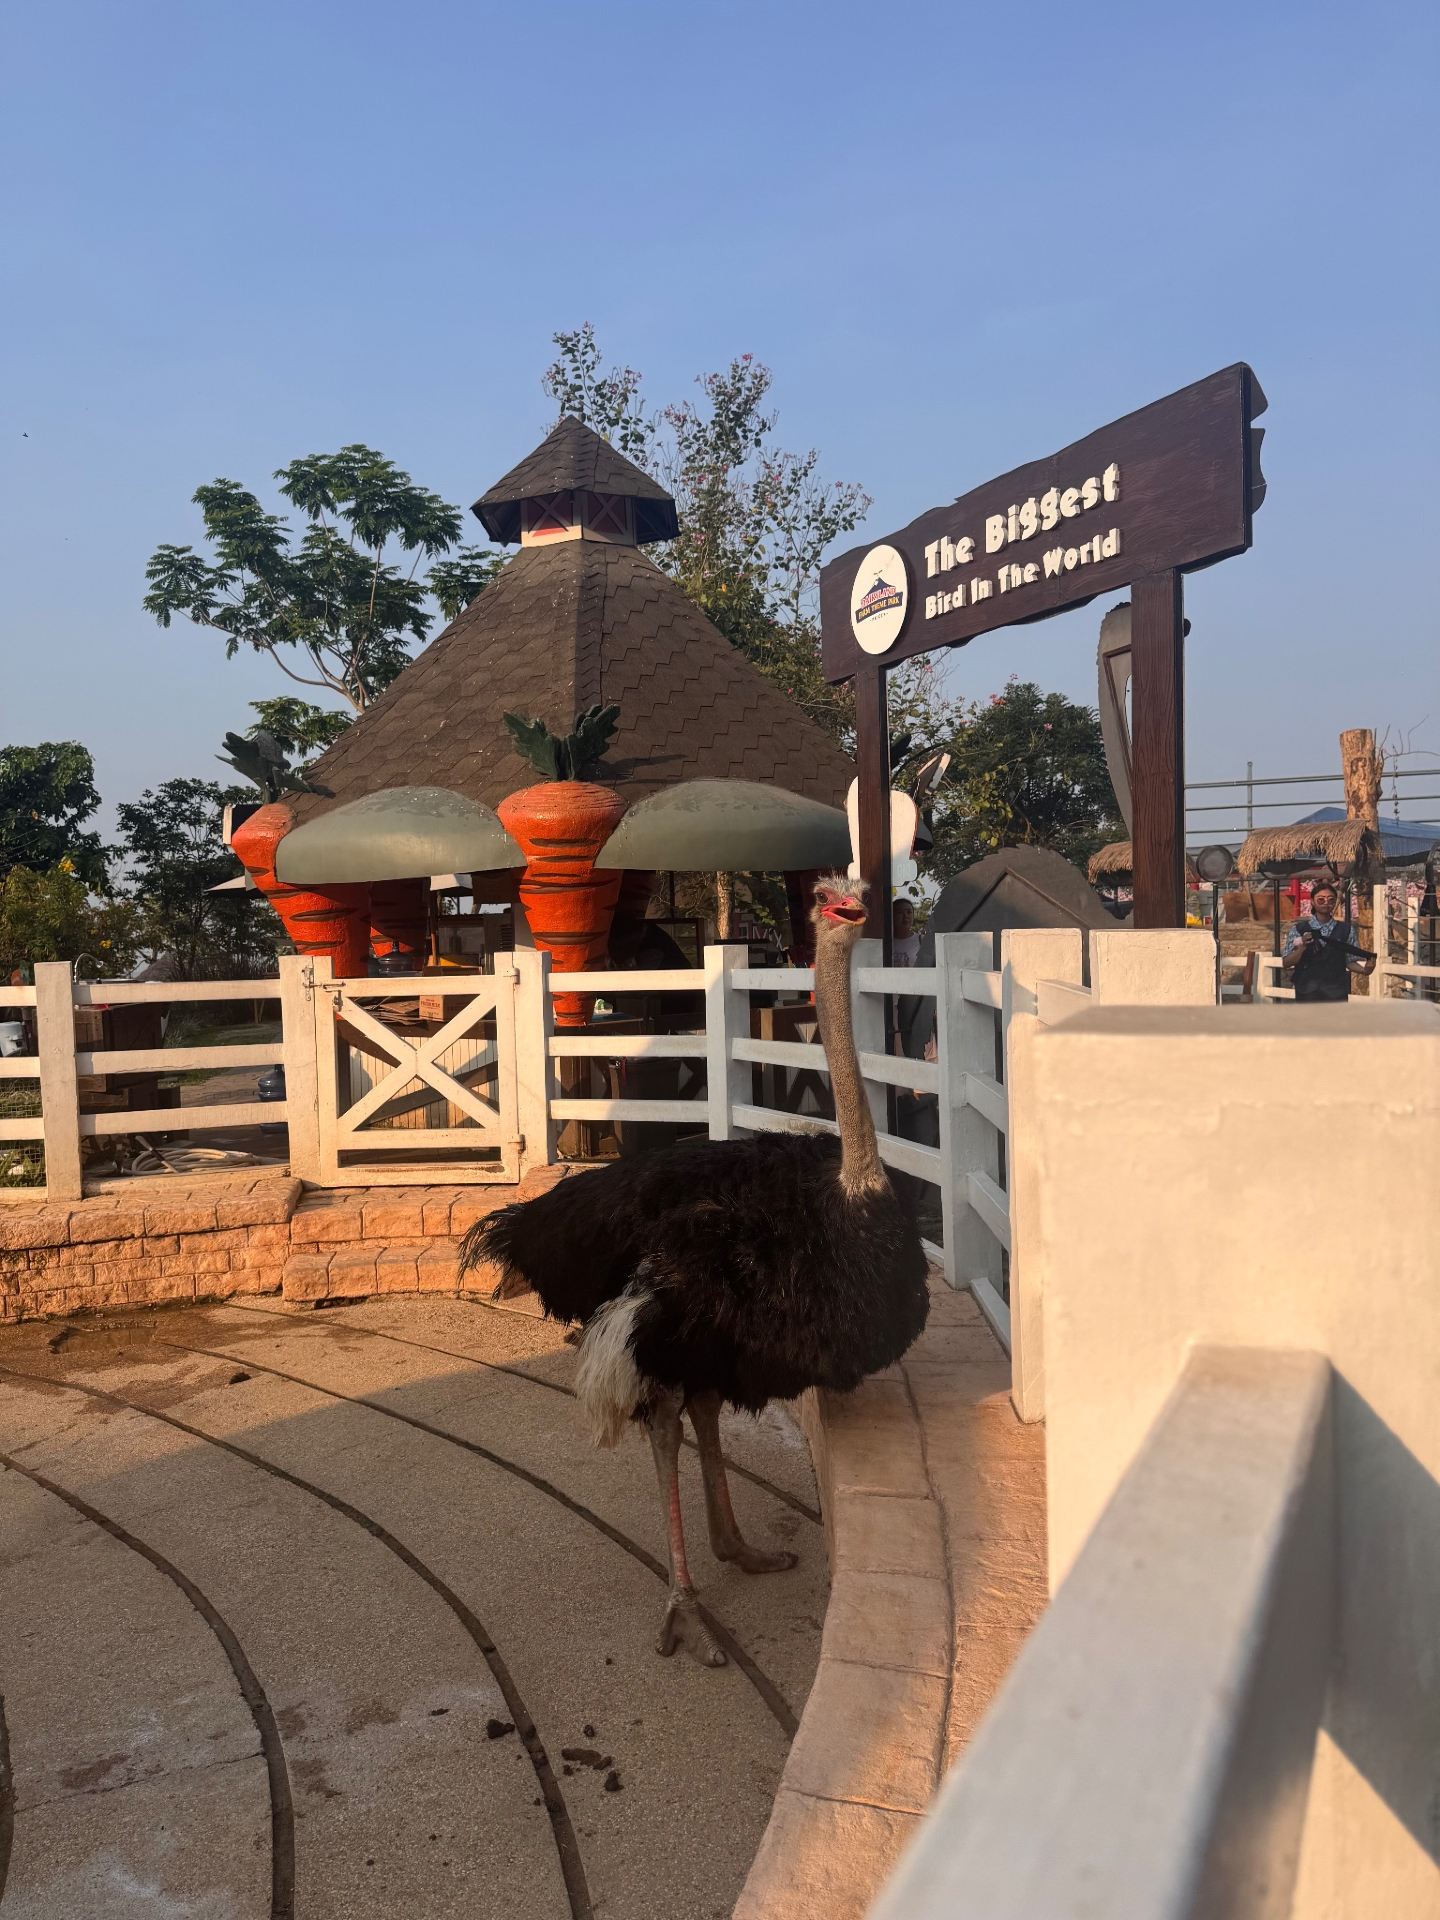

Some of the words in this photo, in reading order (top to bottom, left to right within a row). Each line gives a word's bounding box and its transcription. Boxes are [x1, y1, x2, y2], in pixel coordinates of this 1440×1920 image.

[924, 535, 976, 579] The
[985, 462, 1120, 554] Biggest
[871, 600, 887, 611] THEME
[887, 596, 900, 606] PARK
[925, 583, 967, 620] Bird
[971, 576, 994, 605] In
[997, 562, 1041, 594] The
[1042, 527, 1121, 580] World
